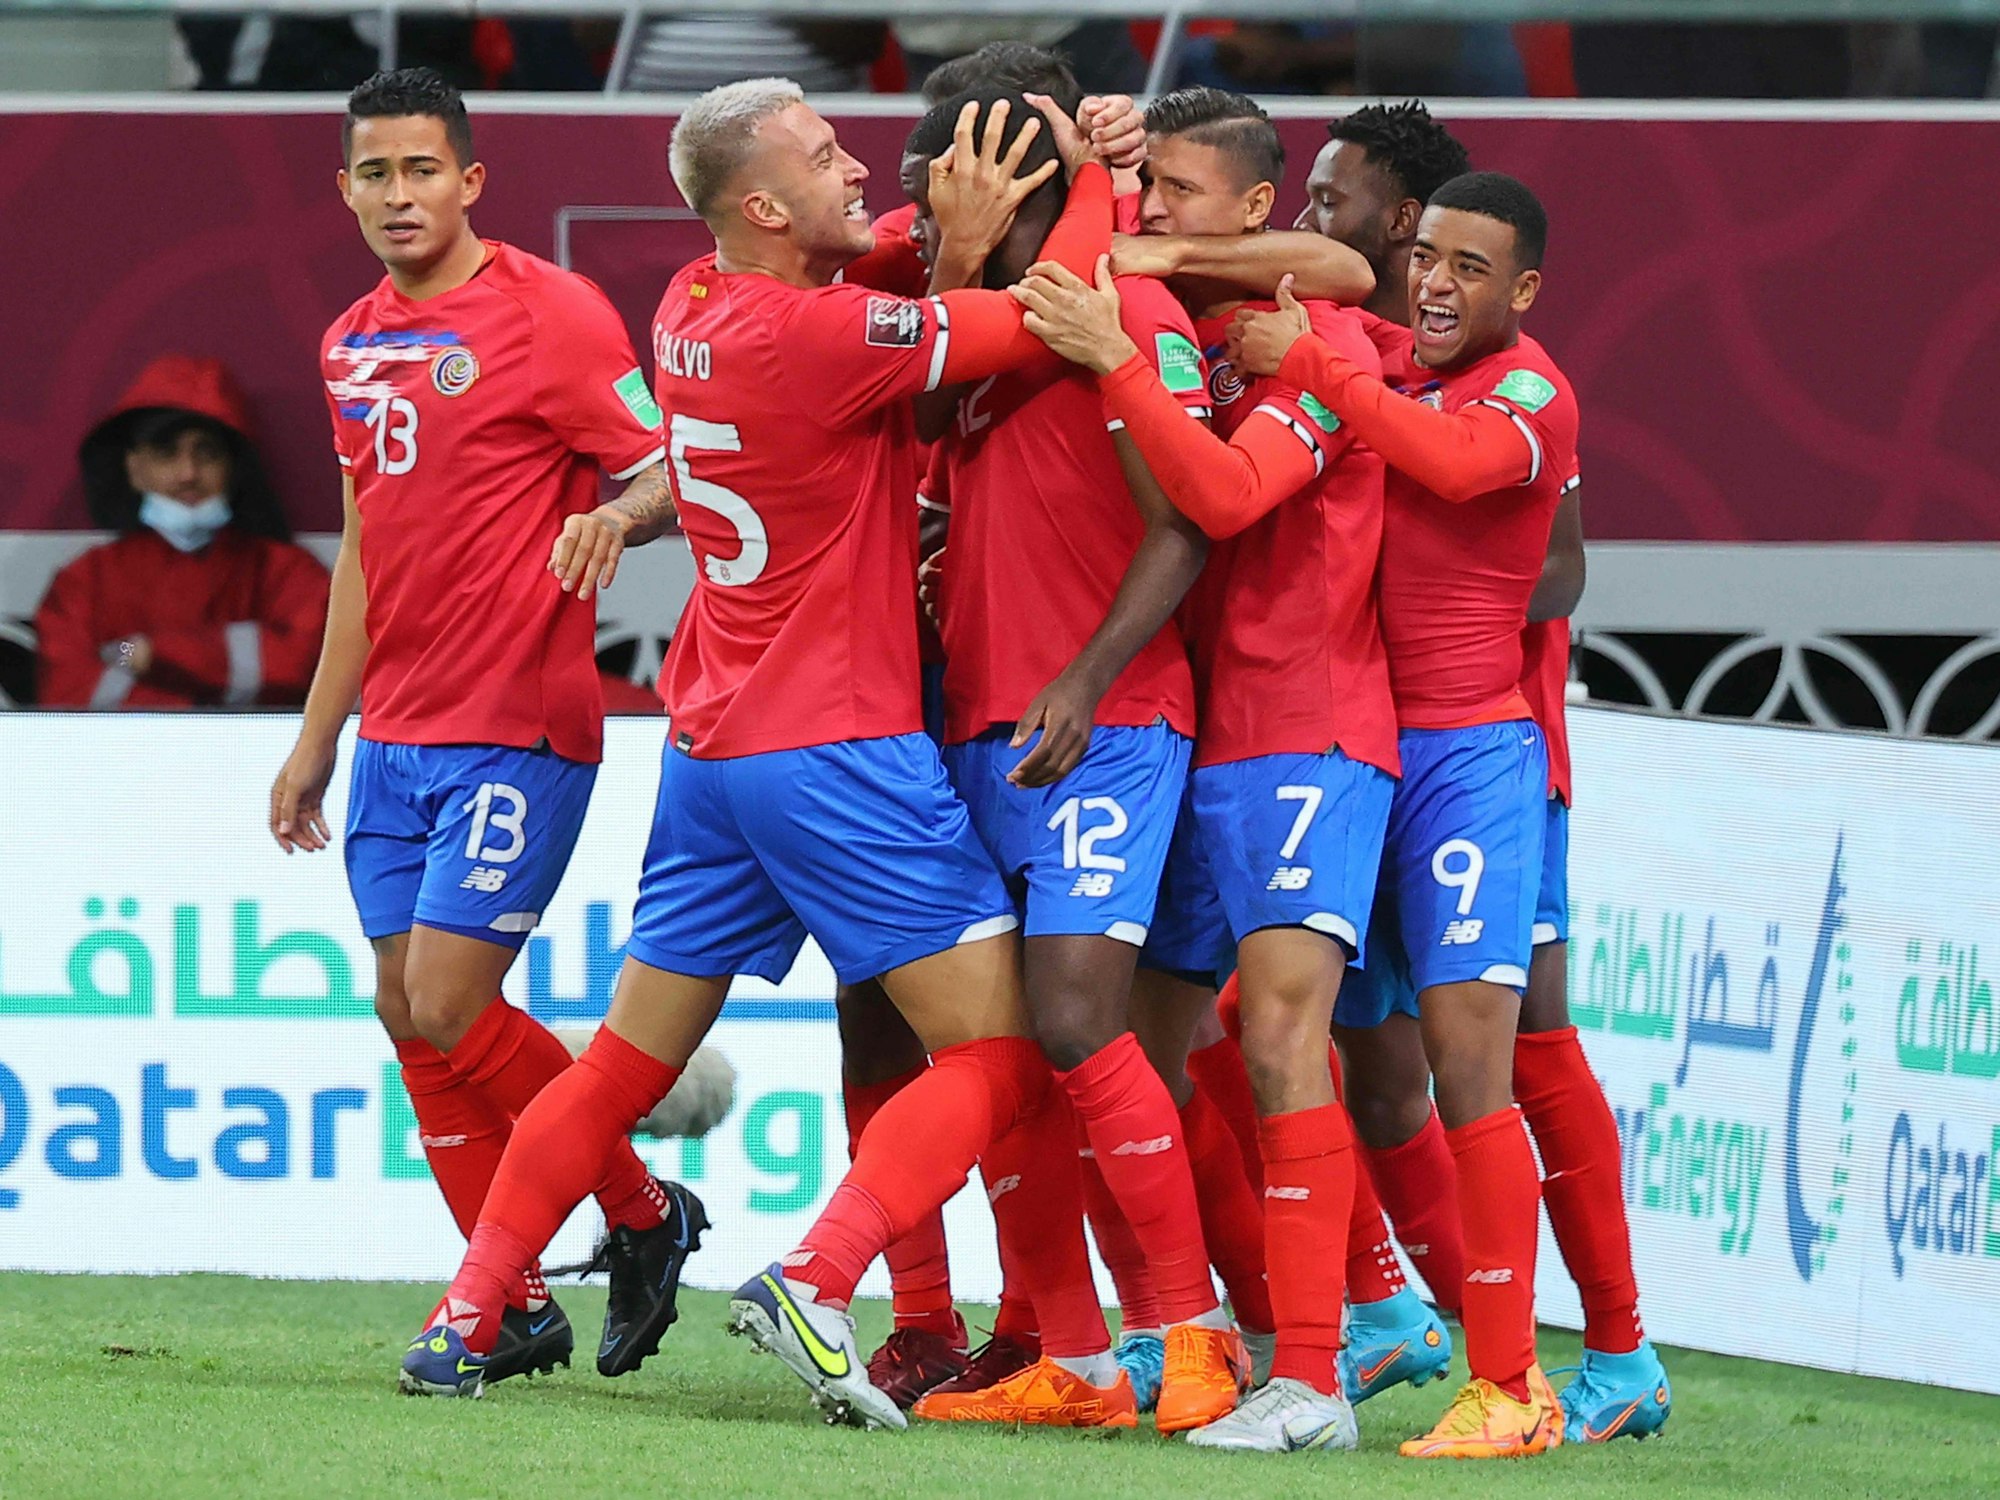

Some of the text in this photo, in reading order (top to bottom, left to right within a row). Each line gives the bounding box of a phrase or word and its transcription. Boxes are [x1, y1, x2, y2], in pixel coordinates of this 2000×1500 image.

[364, 398, 420, 475] 13
[670, 413, 769, 587] 5
[462, 782, 528, 863] 13
[1046, 796, 1129, 873] 12
[1276, 785, 1324, 860] 7
[1431, 838, 1485, 915] 9
[1674, 914, 1781, 1088] قطر
